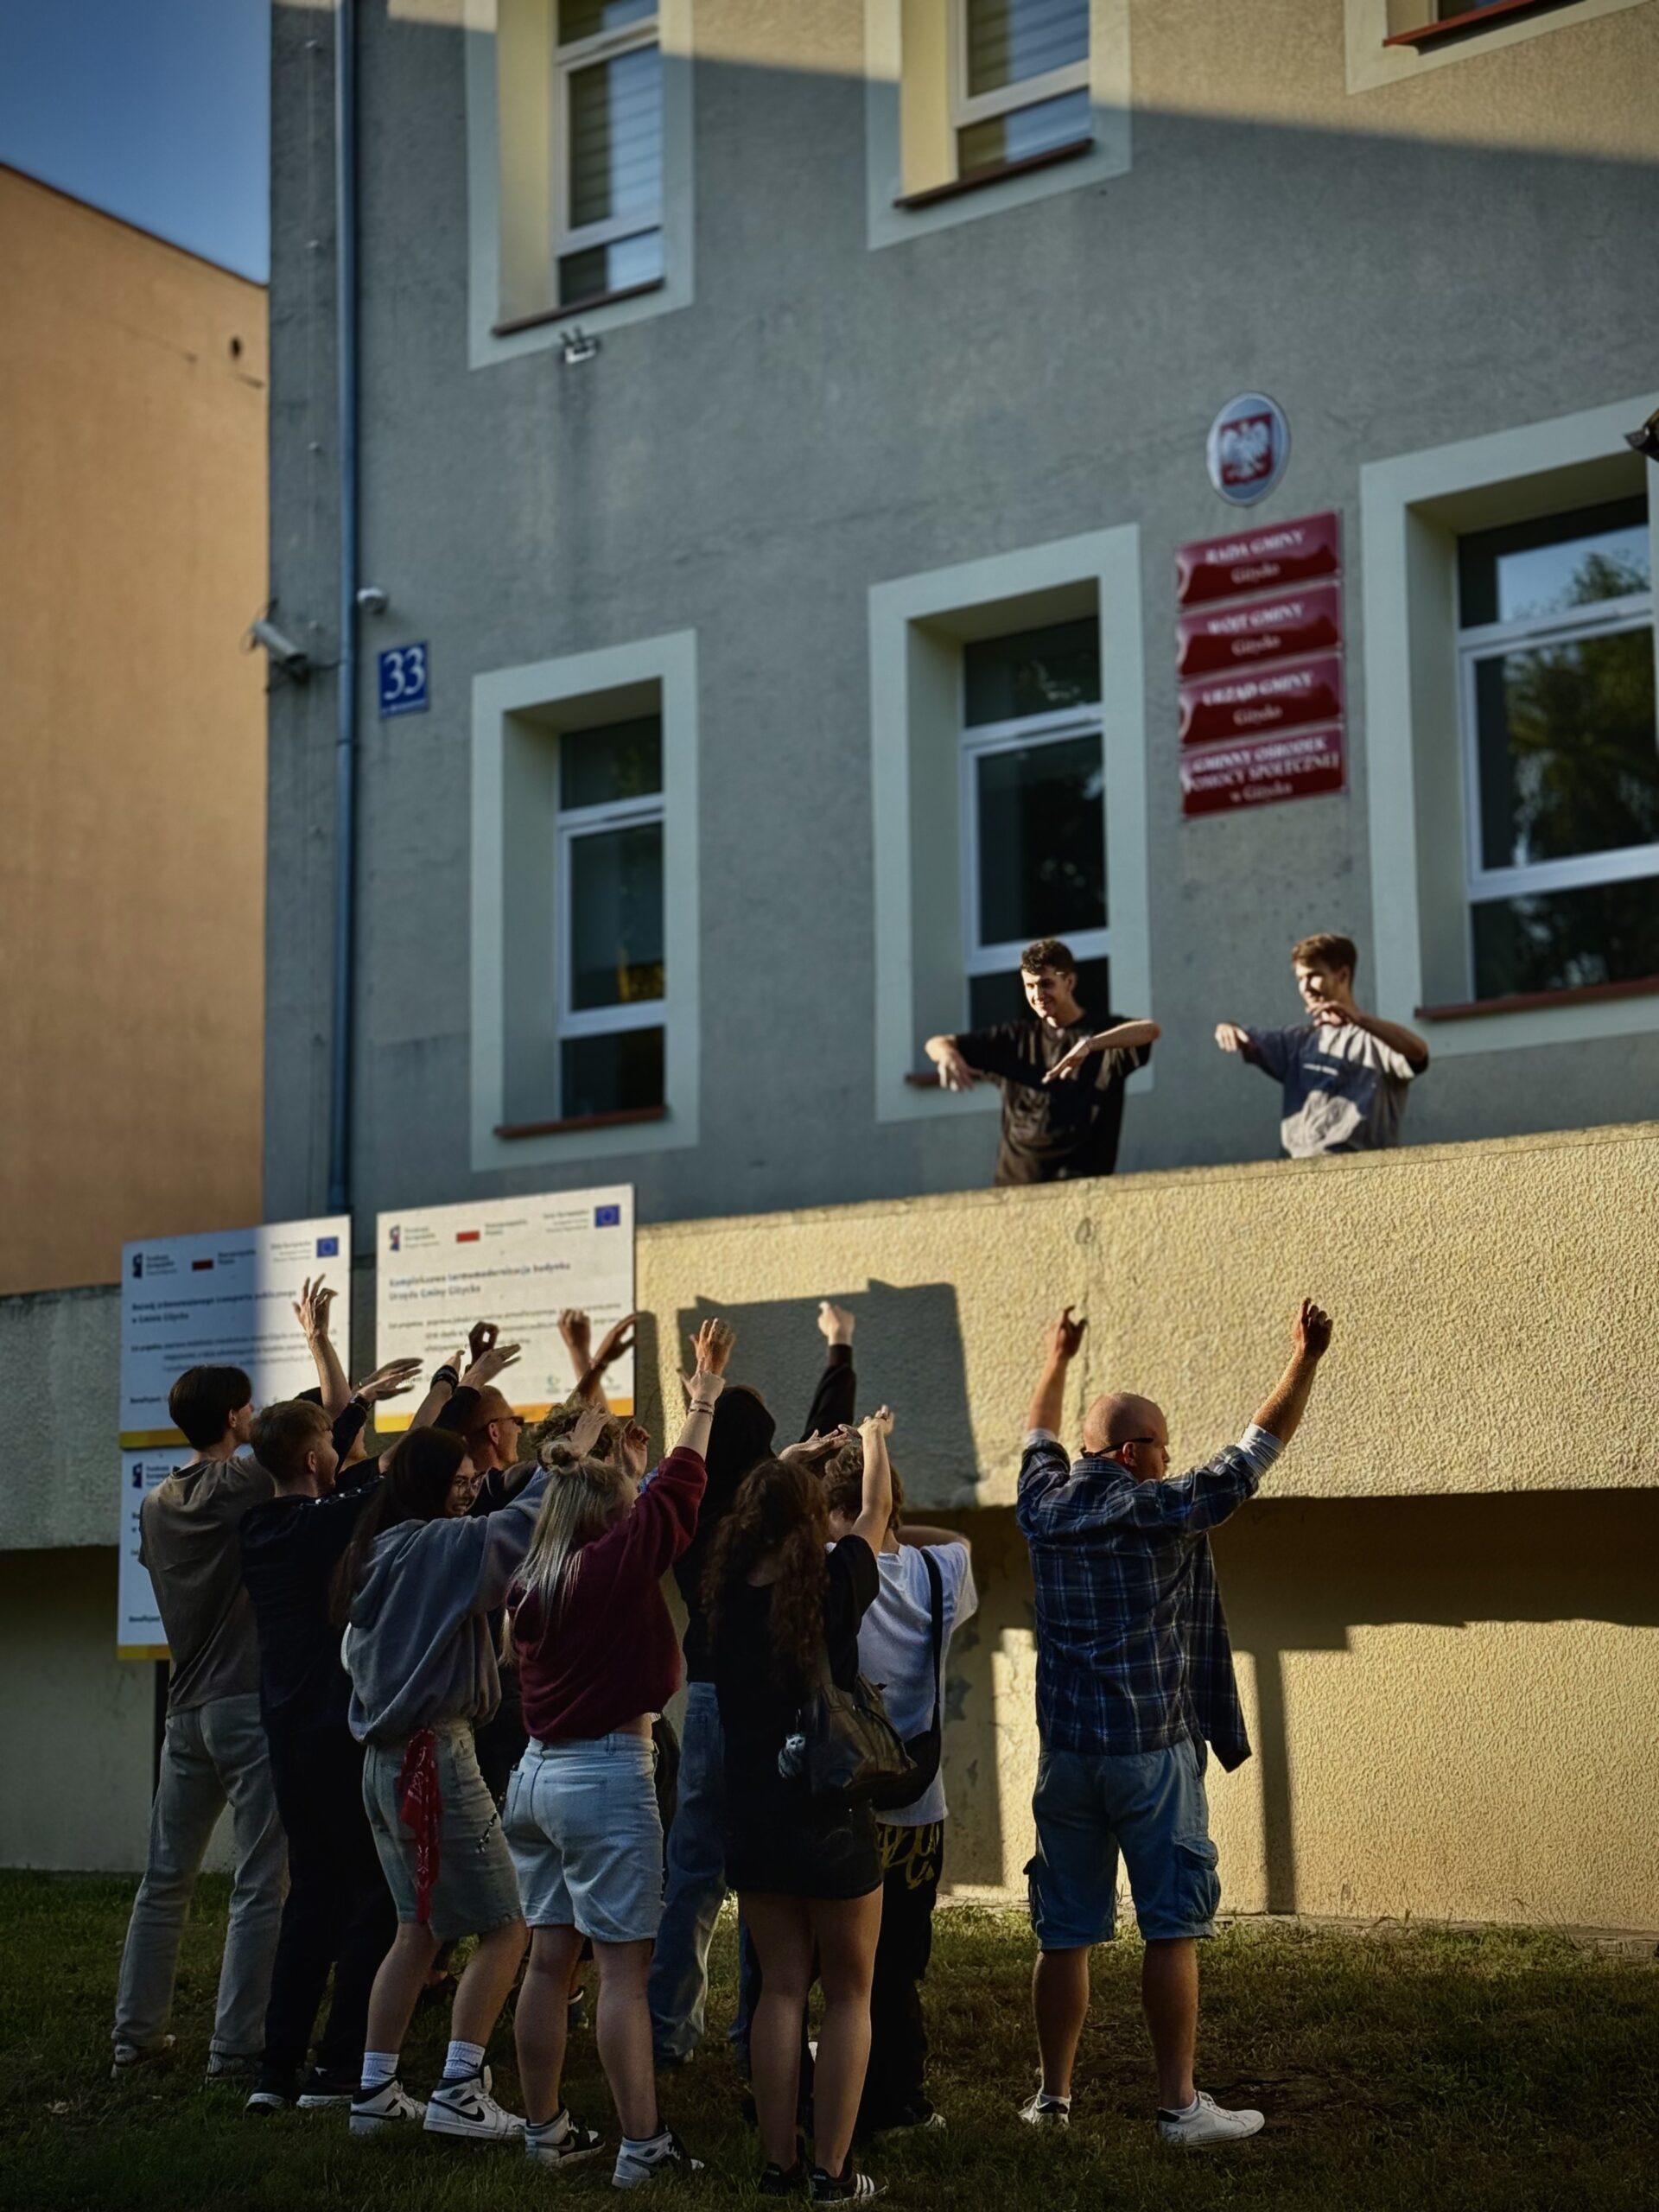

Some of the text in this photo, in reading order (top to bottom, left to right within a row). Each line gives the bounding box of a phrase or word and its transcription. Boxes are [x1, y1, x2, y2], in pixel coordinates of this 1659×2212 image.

[1250, 529, 1306, 555] GMINY
[1249, 603, 1306, 626] GMINY
[384, 647, 426, 701] 33
[1259, 671, 1314, 696] GMINY
